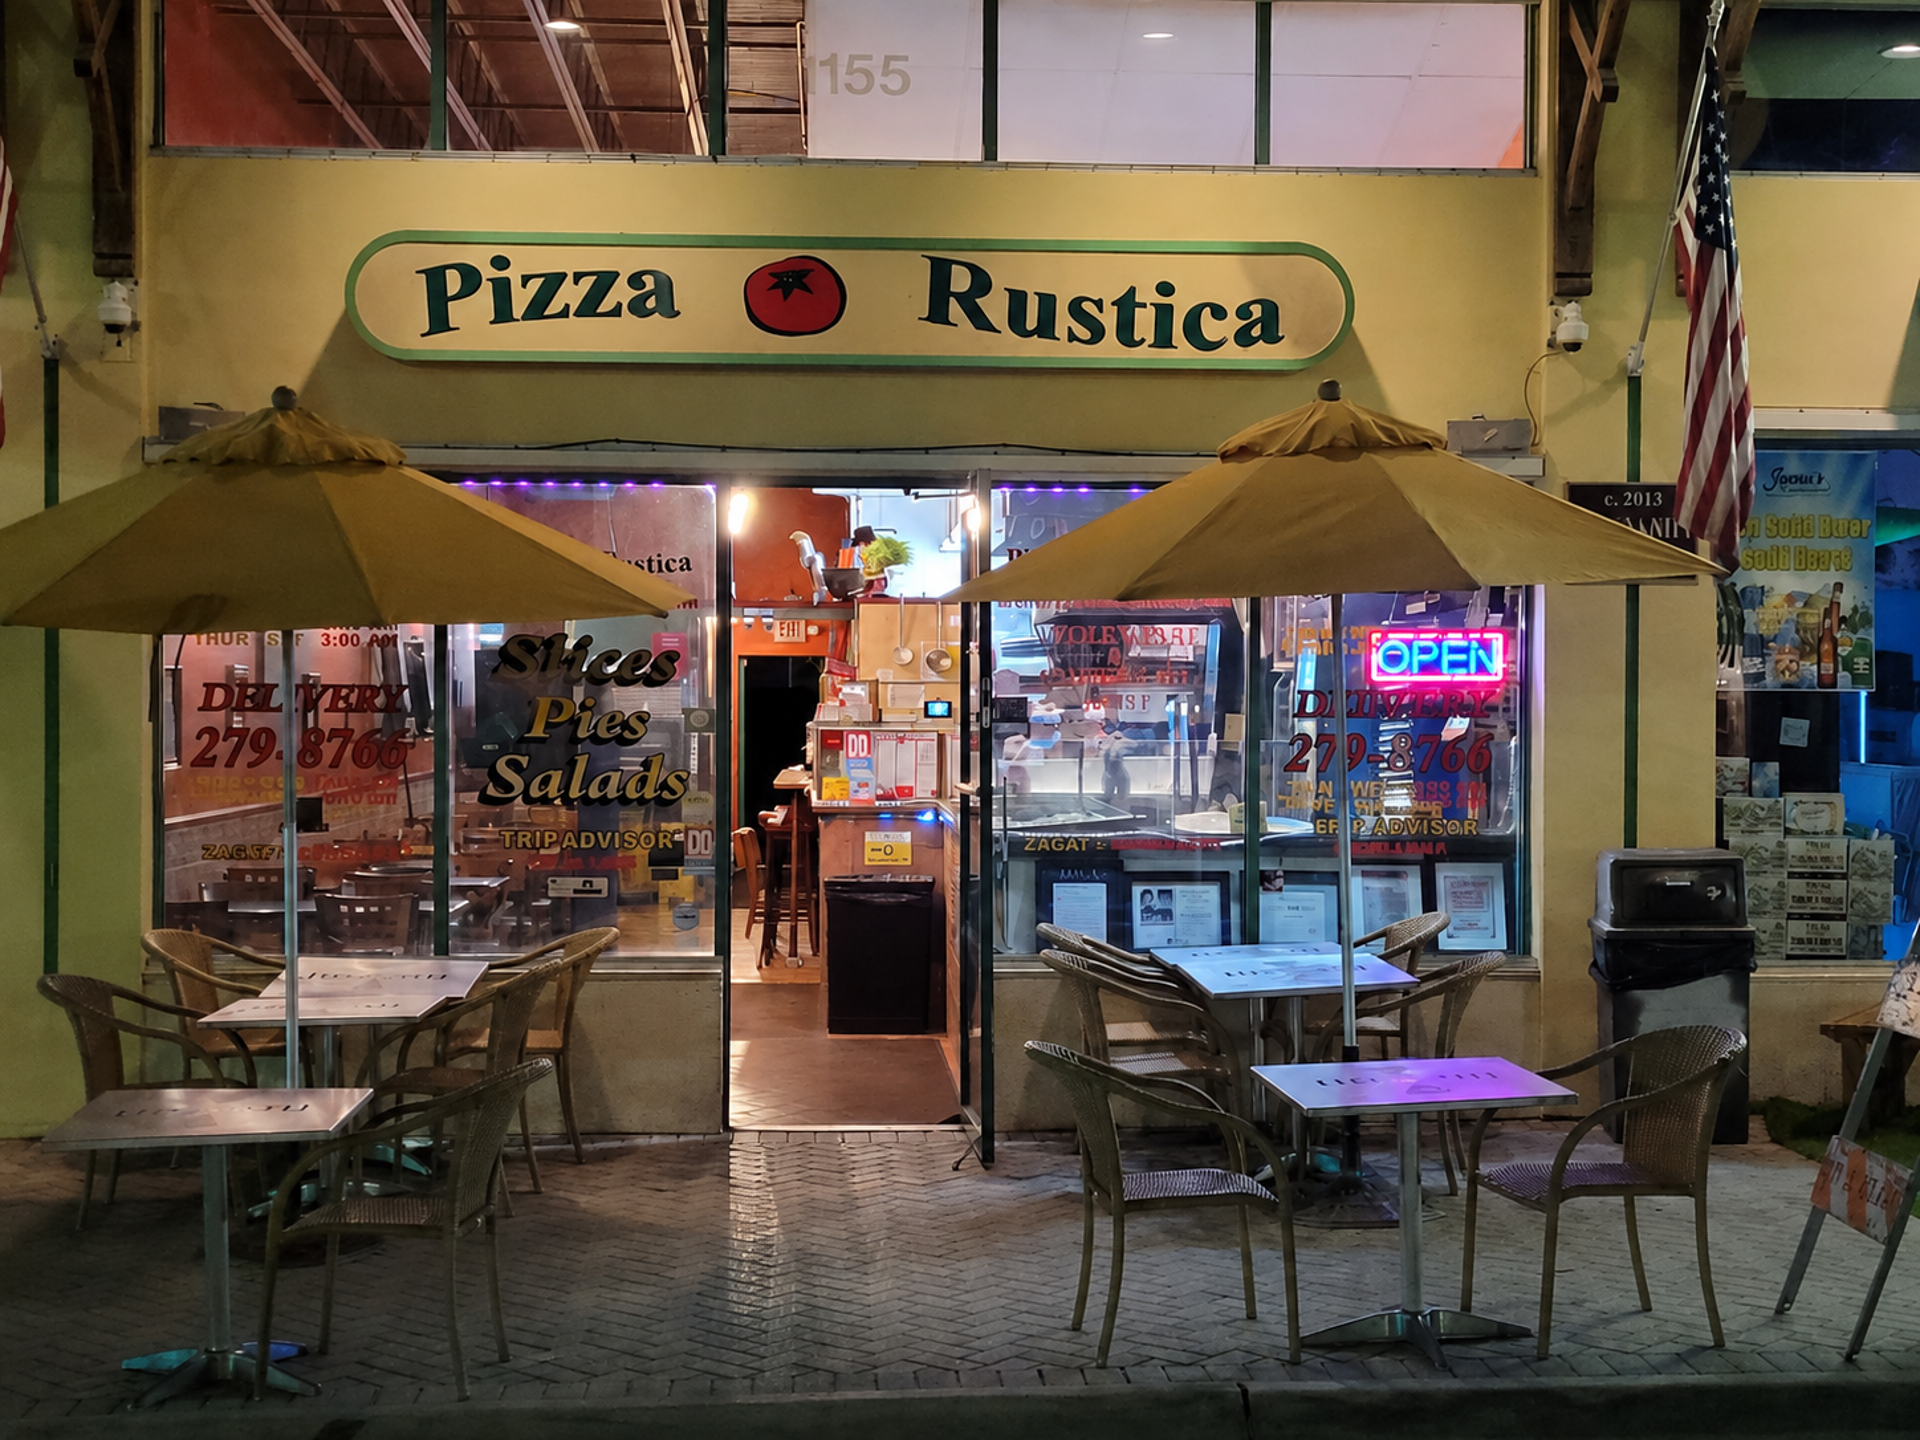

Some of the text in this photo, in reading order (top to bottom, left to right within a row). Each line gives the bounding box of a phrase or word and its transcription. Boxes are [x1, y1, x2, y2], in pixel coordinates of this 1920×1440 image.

[415, 254, 1285, 352] Pizza Rustica
[1623, 491, 1663, 506] 2013
[321, 634, 360, 647] 3:00
[494, 632, 681, 686] Slices
[1377, 639, 1497, 674] OPEN
[521, 696, 652, 747] Pies
[190, 727, 411, 769] 279-8766
[1283, 732, 1495, 774] 279-8766
[478, 753, 690, 806] Salads
[1023, 837, 1090, 852] ZAGAT
